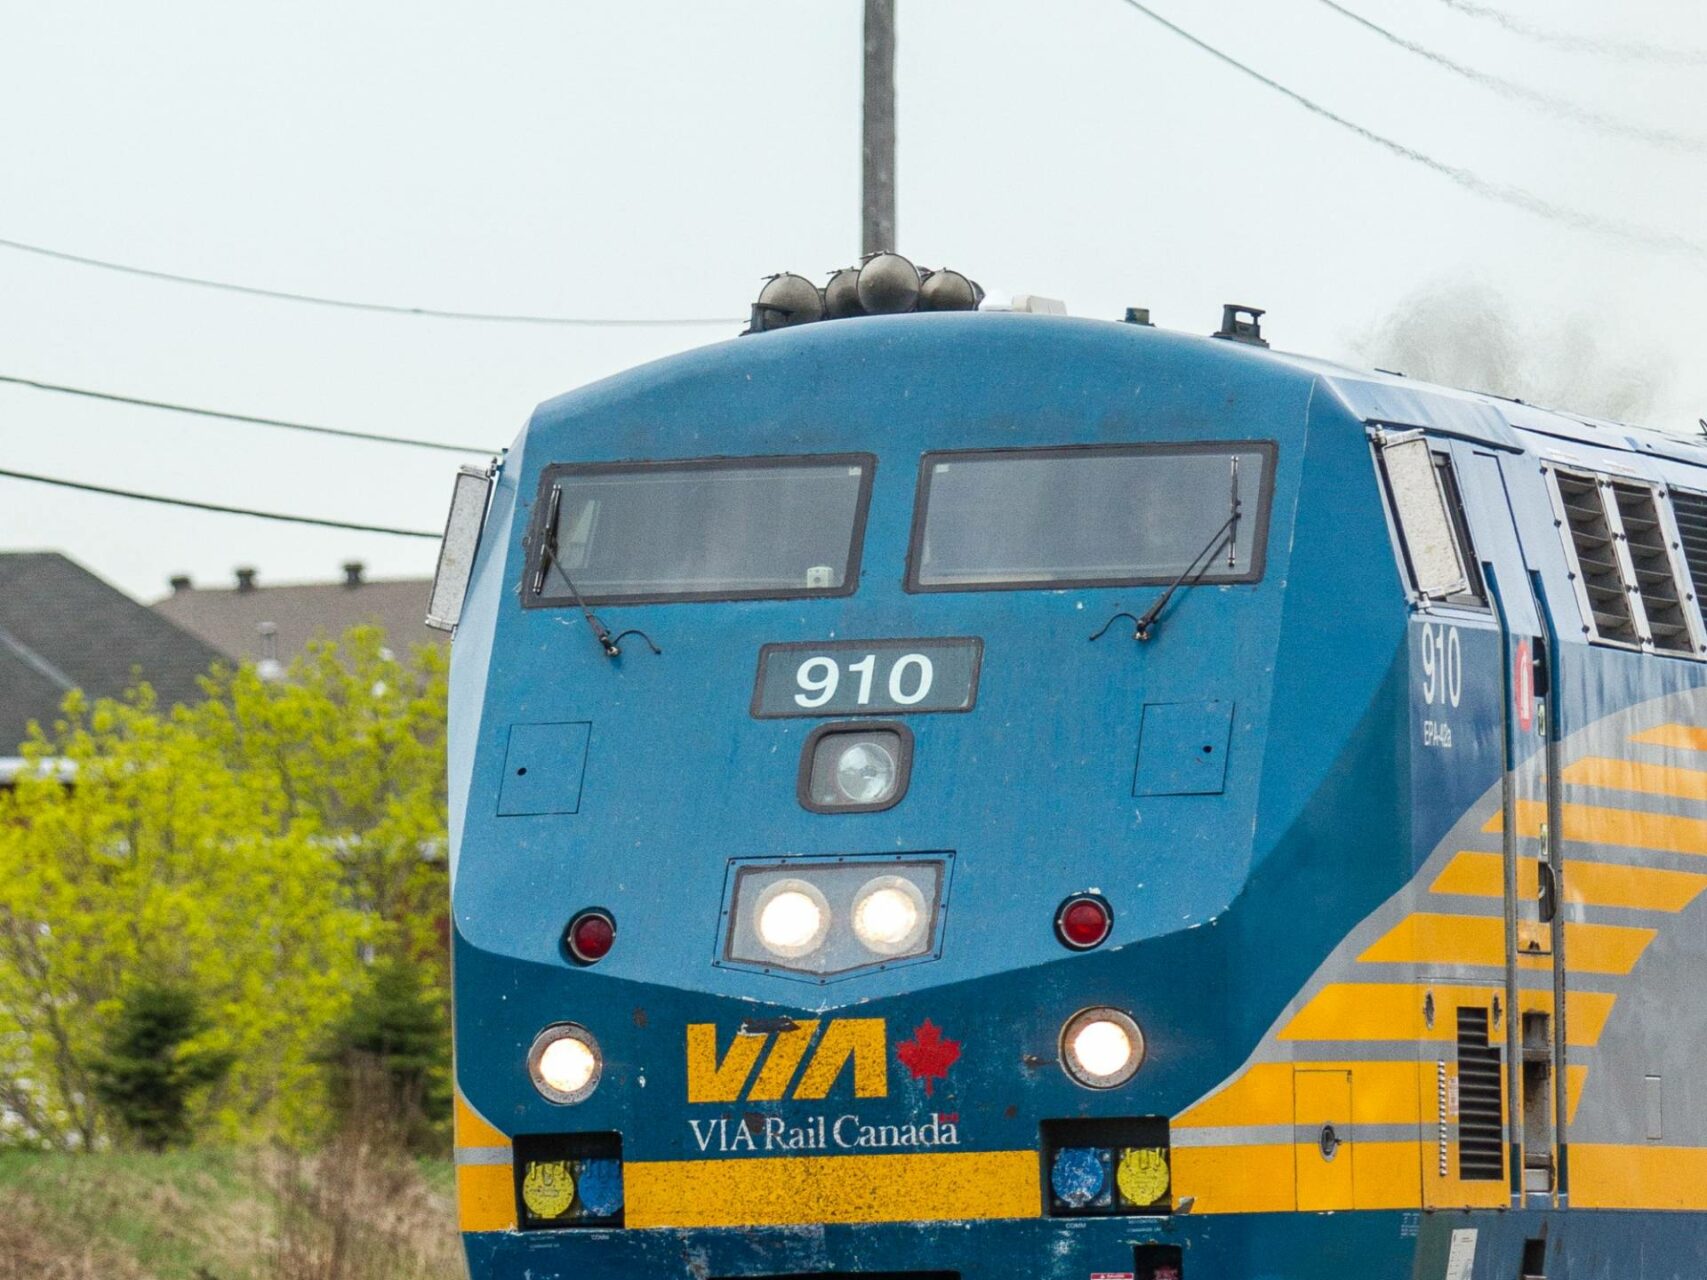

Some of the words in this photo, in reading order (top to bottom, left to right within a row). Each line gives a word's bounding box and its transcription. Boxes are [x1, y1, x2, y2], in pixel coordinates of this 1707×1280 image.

[794, 653, 934, 708] 910
[1421, 622, 1462, 708] 910
[686, 1017, 888, 1104] VIA
[688, 1118, 758, 1152] VIA
[764, 1115, 827, 1151] Rail
[832, 1113, 961, 1148] Canada
